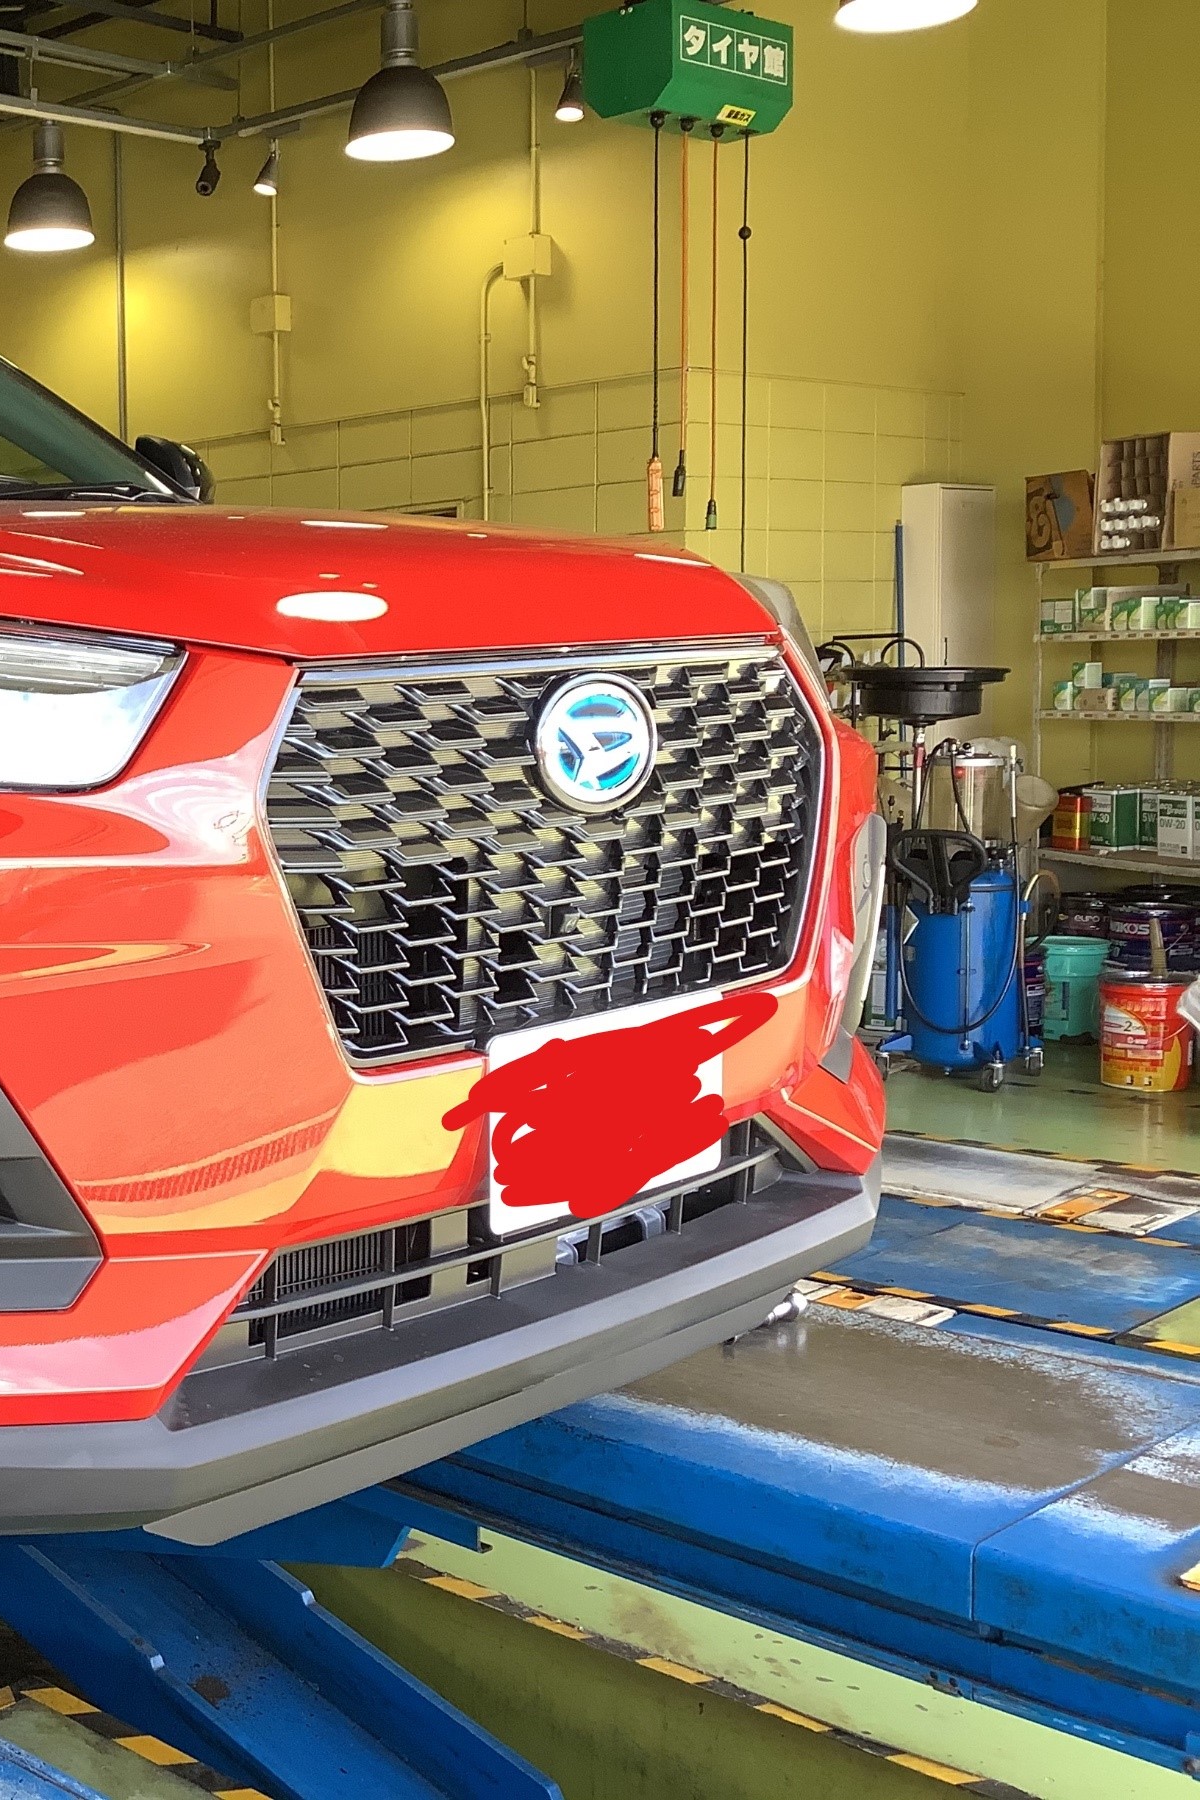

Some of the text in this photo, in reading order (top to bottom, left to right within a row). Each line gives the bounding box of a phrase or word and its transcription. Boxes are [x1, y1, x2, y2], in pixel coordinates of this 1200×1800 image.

[683, 24, 785, 78] タイヤ館
[1074, 914, 1100, 923] euro
